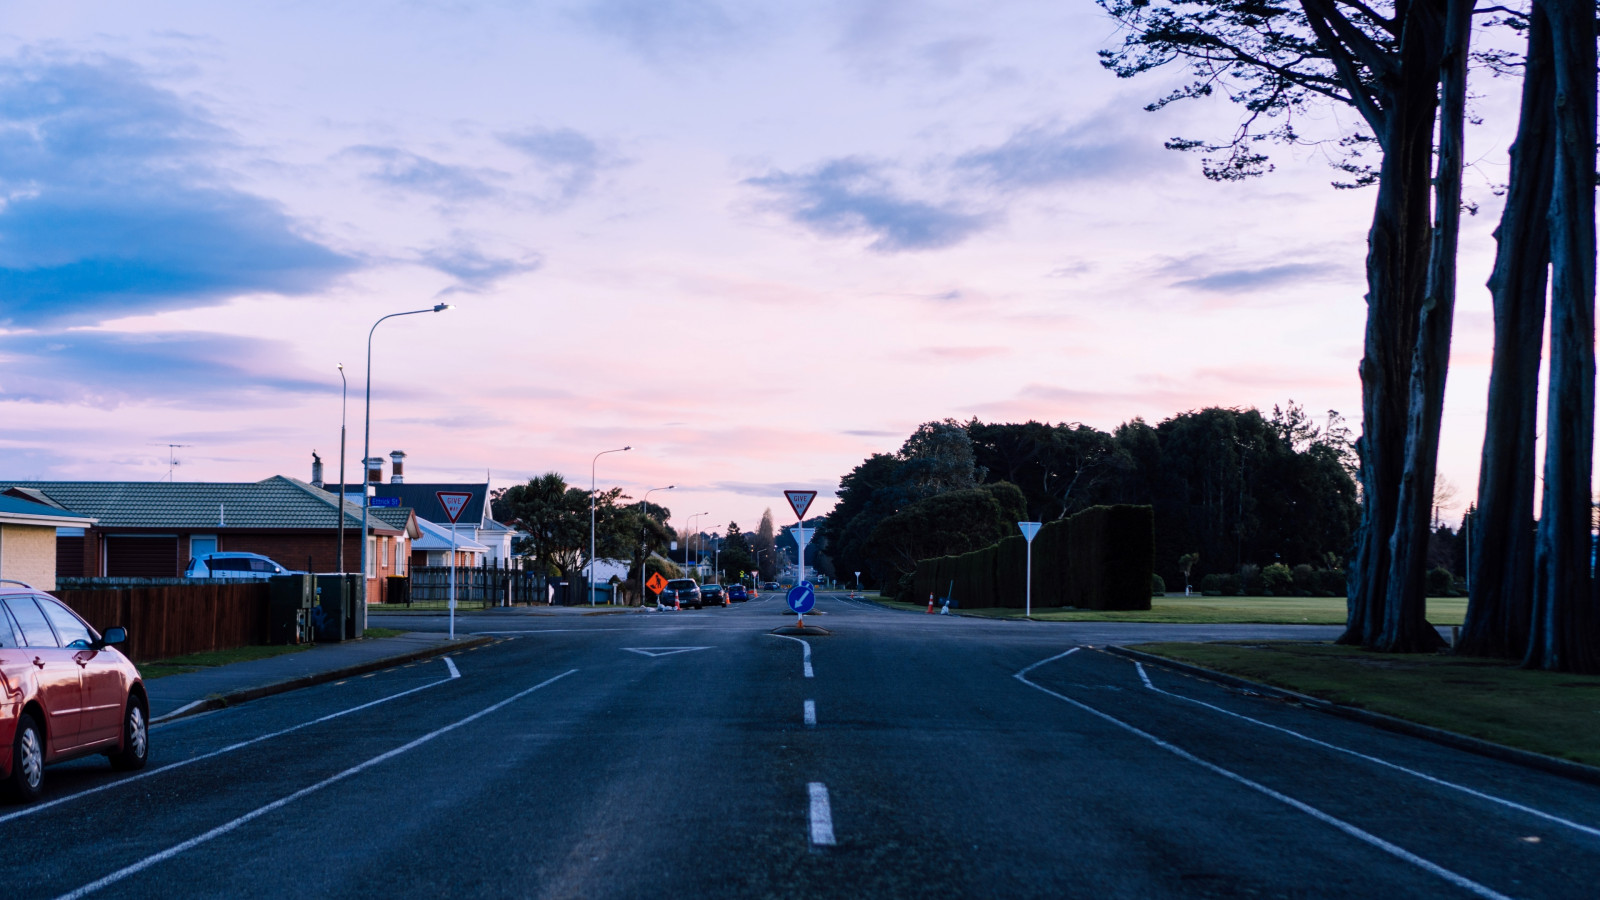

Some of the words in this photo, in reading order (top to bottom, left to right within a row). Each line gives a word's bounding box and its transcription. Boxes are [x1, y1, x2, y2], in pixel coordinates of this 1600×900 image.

[372, 497, 391, 505] Ettrick
[391, 497, 398, 505] St
[446, 497, 462, 505] GIVE
